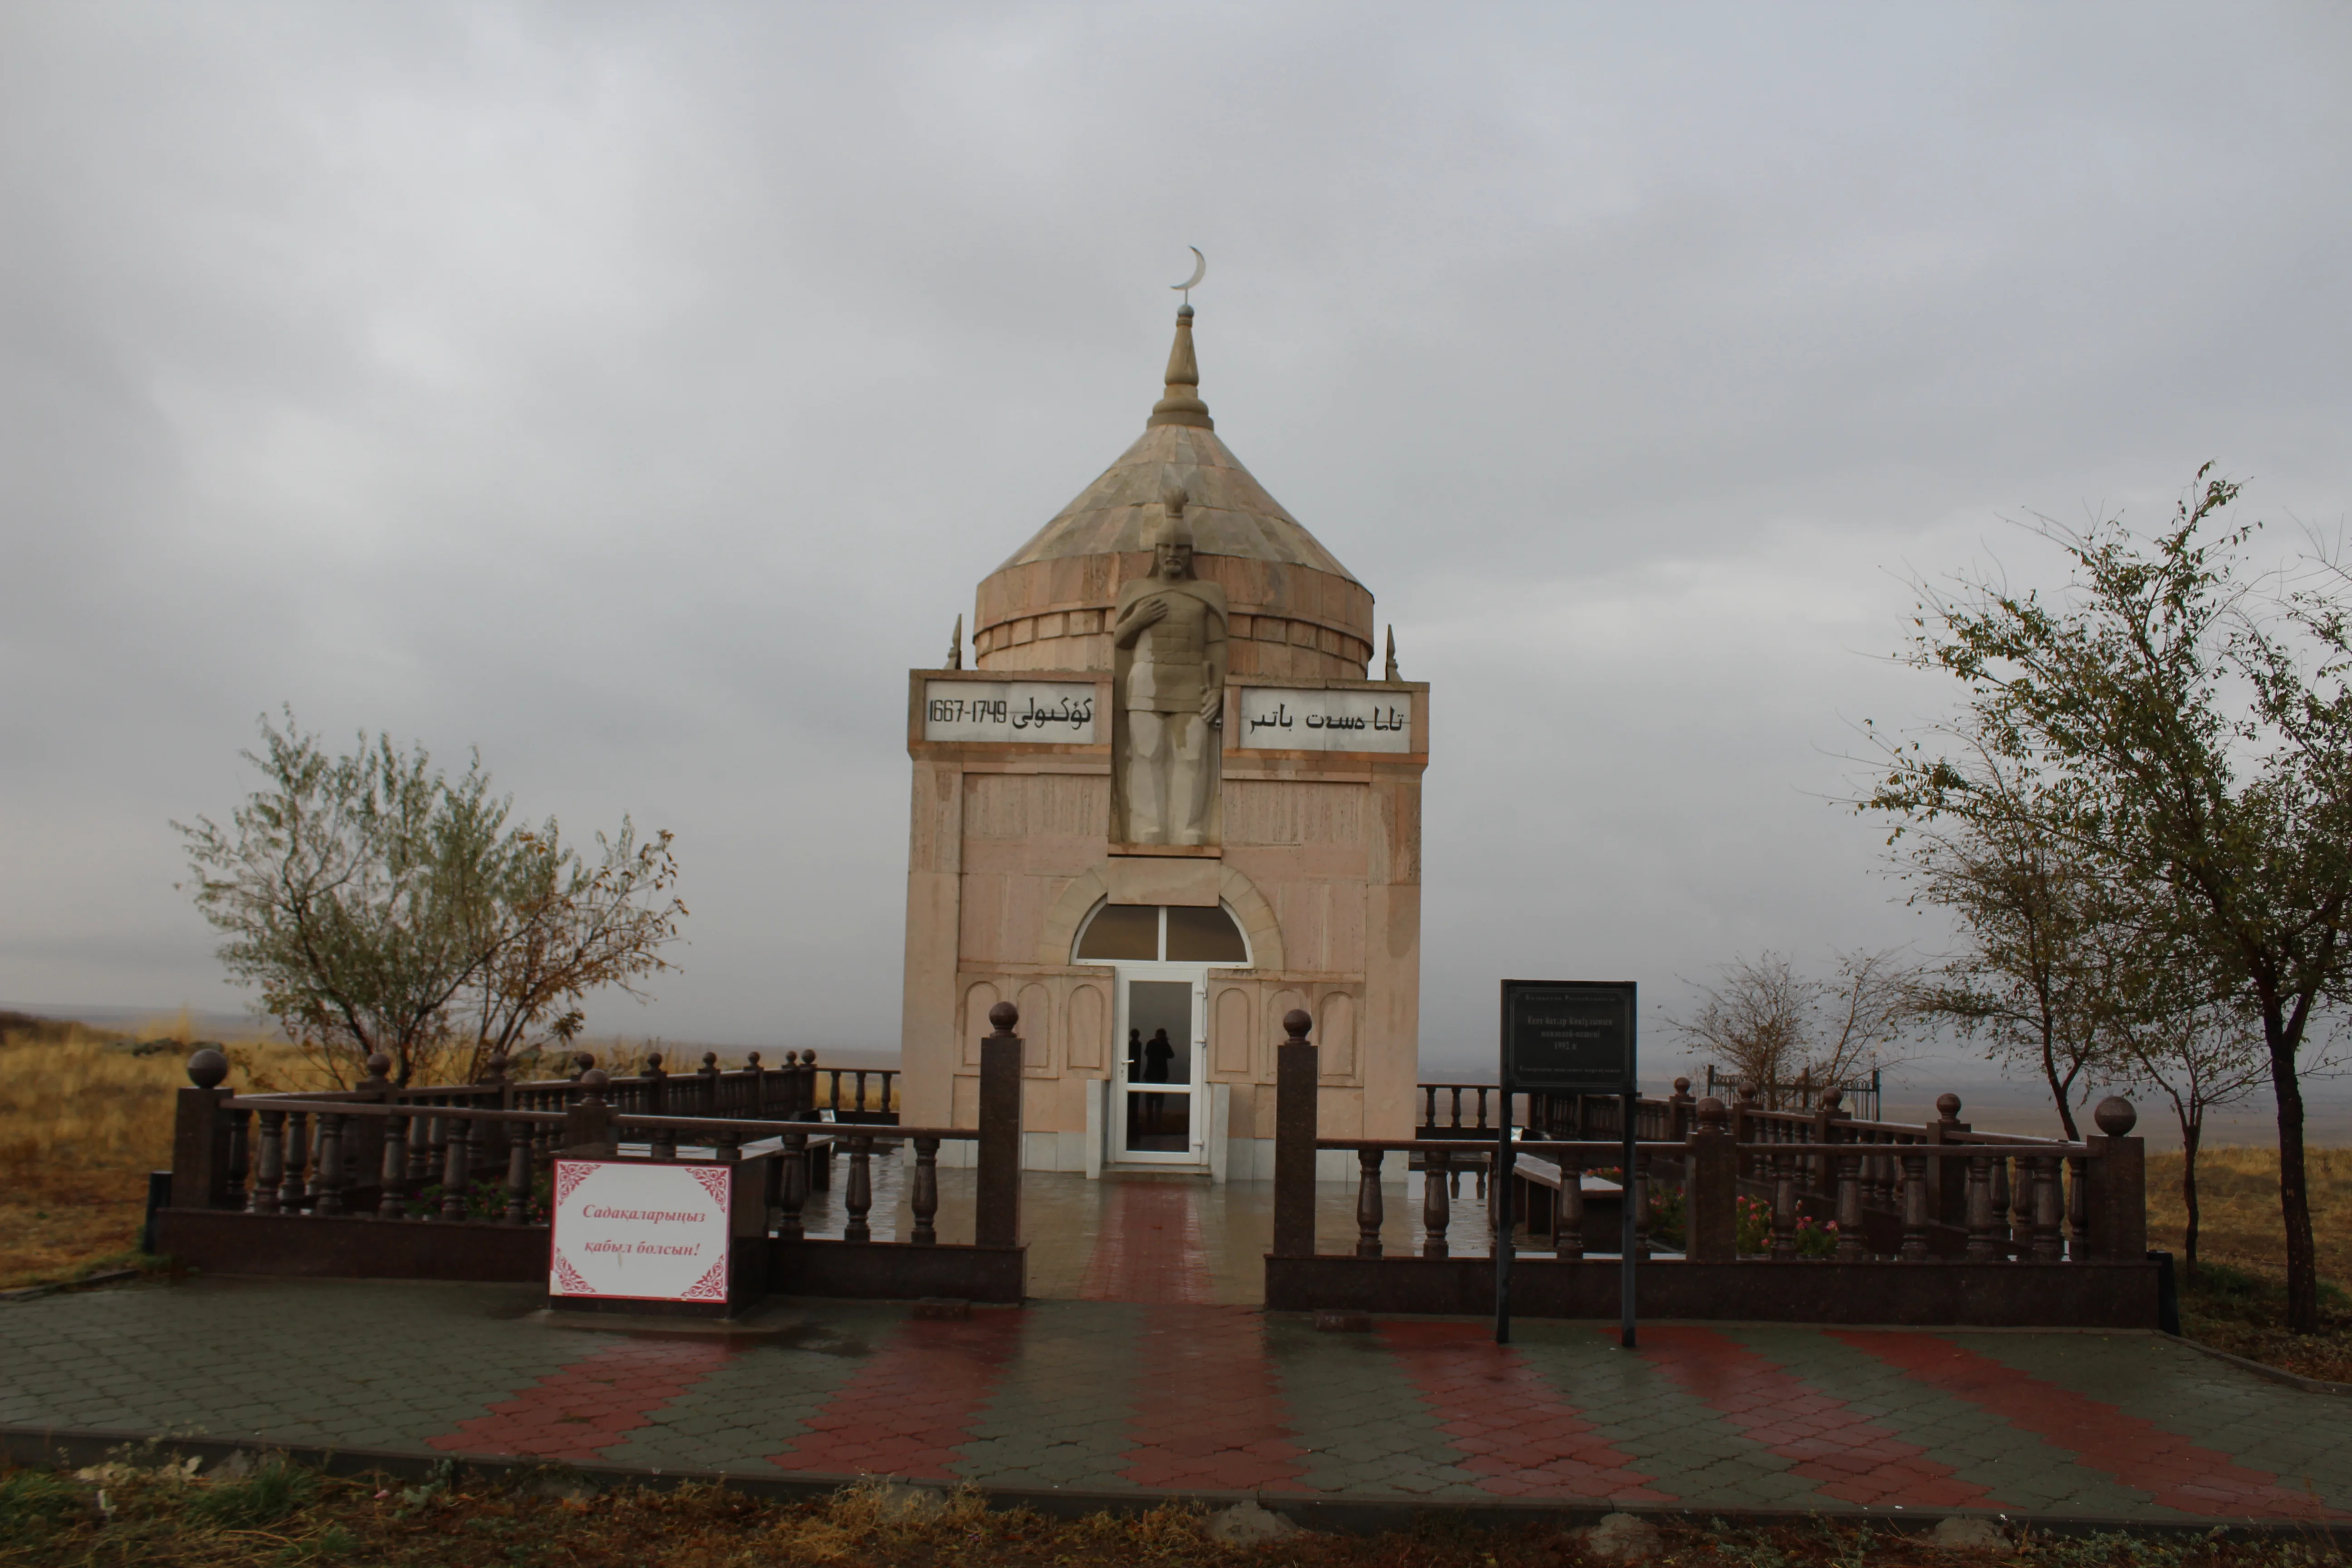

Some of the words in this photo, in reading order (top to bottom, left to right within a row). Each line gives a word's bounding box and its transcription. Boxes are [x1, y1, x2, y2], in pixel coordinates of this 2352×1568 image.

[929, 700, 1007, 724] 1667-1749
[583, 1204, 706, 1224] Садақаларыңыз
[584, 1240, 633, 1255] қабыл
[637, 1241, 701, 1256] болсын!
